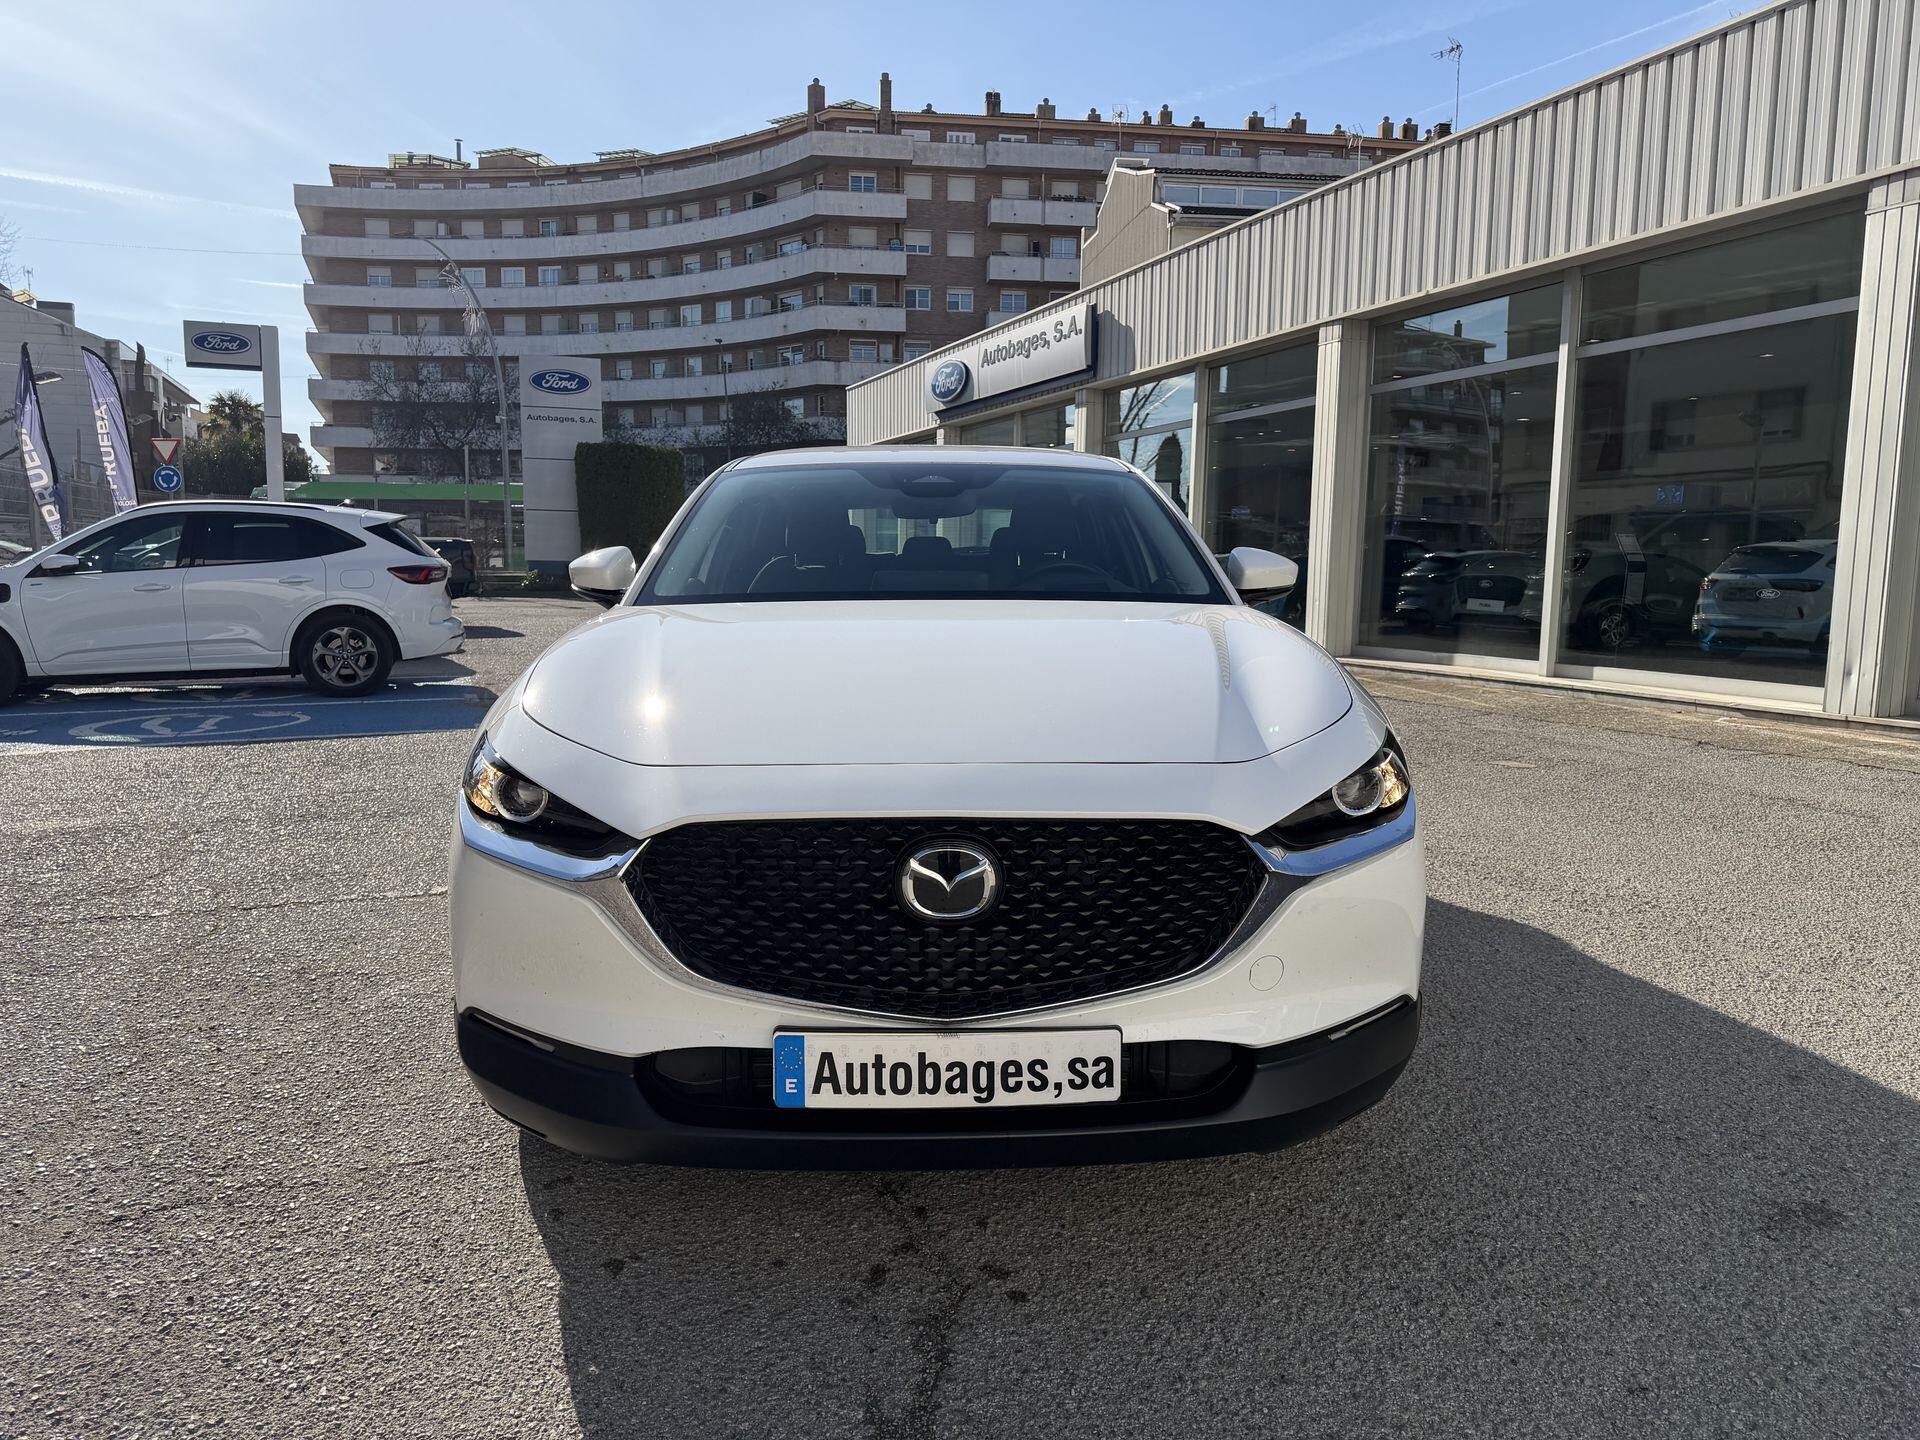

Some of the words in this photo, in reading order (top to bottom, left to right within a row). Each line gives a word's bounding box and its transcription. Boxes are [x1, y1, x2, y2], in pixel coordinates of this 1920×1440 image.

[203, 334, 240, 351] Ford
[980, 330, 1050, 368] Autobages,
[1053, 315, 1083, 343] S.A.
[542, 373, 578, 389] Ford
[935, 366, 960, 392] Ford
[526, 413, 578, 424] Autobages,
[579, 416, 597, 424] S.A.
[21, 427, 60, 523] PRUEB
[785, 1079, 798, 1093] E
[811, 1051, 1115, 1104] Autobages,sa
